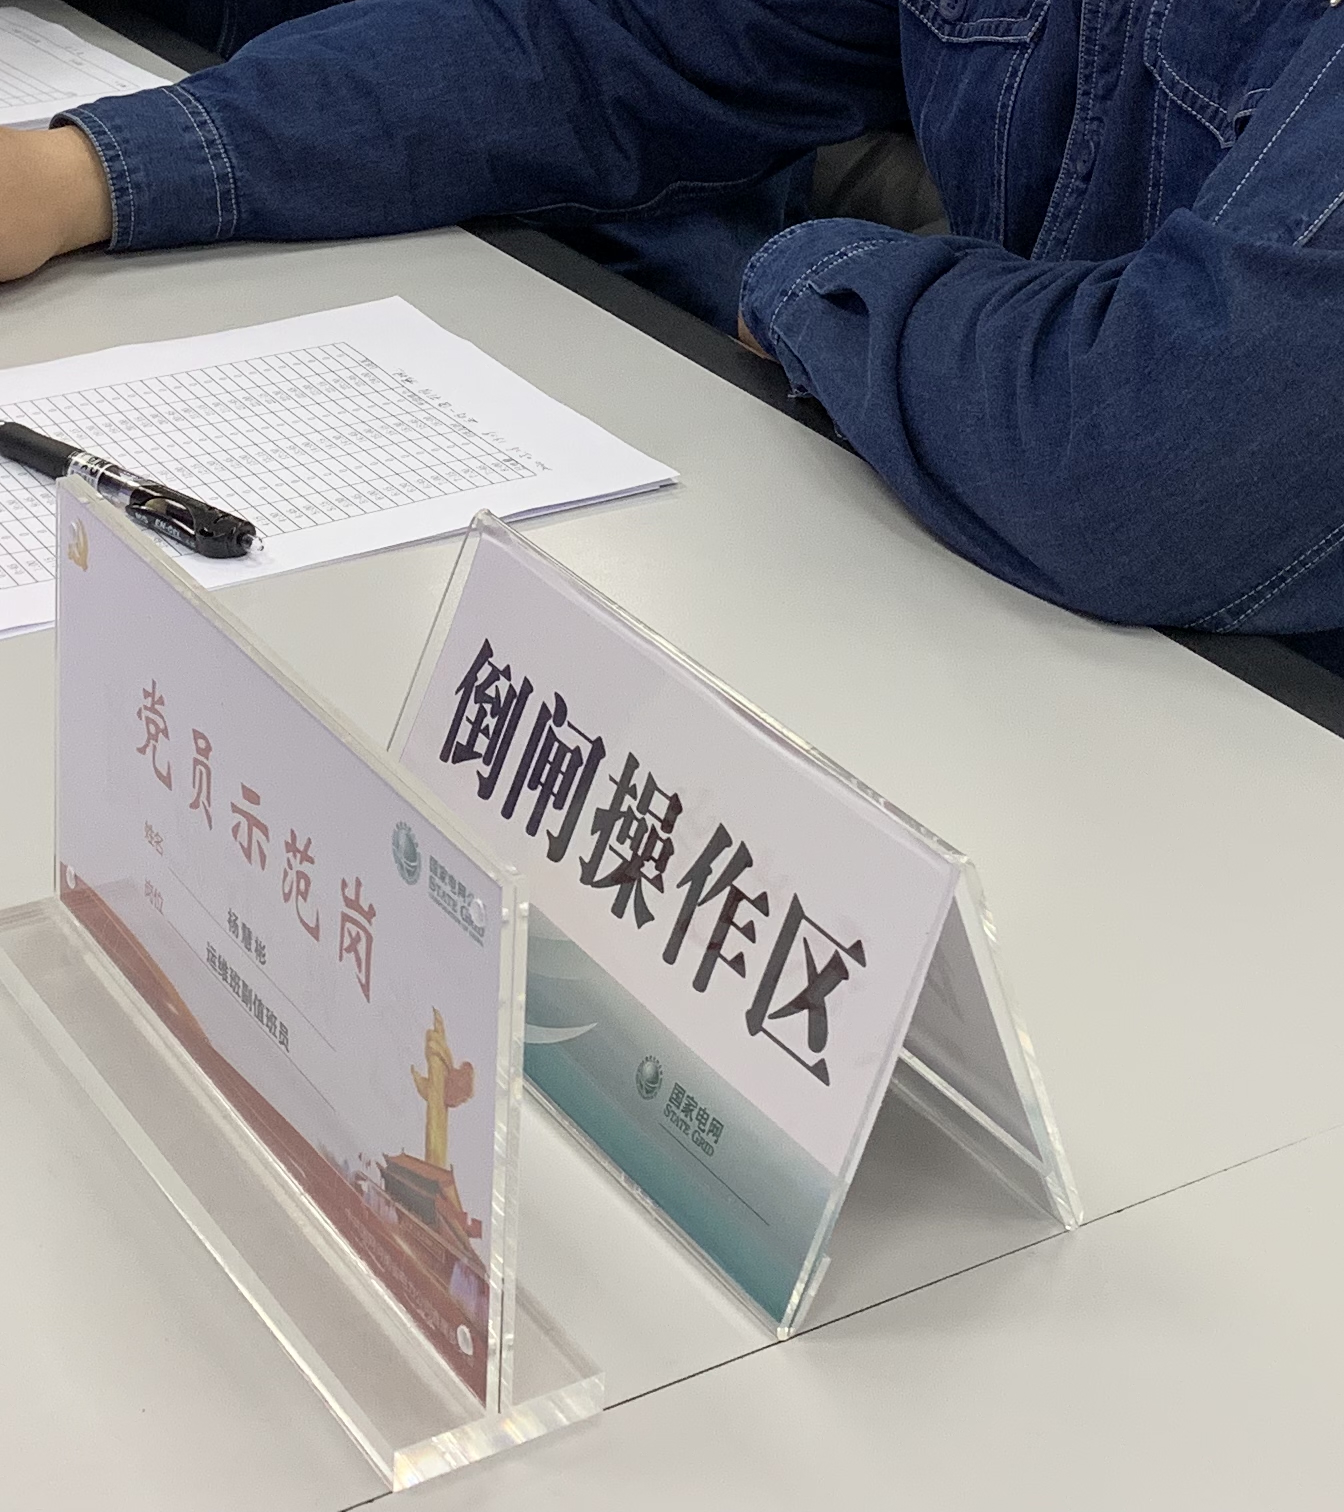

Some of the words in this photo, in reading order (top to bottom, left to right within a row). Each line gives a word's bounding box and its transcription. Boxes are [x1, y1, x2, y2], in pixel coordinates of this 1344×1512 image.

[135, 678, 377, 1003] 党员示范岗
[144, 820, 164, 856] 姓名
[439, 637, 867, 1087] 倒闸操作区
[226, 908, 267, 966] 杨慧彬
[206, 941, 290, 1053] 运维班副值班员
[664, 1103, 690, 1136] STATE
[691, 1130, 714, 1157] GRID
[669, 1082, 724, 1144] 国家电网
